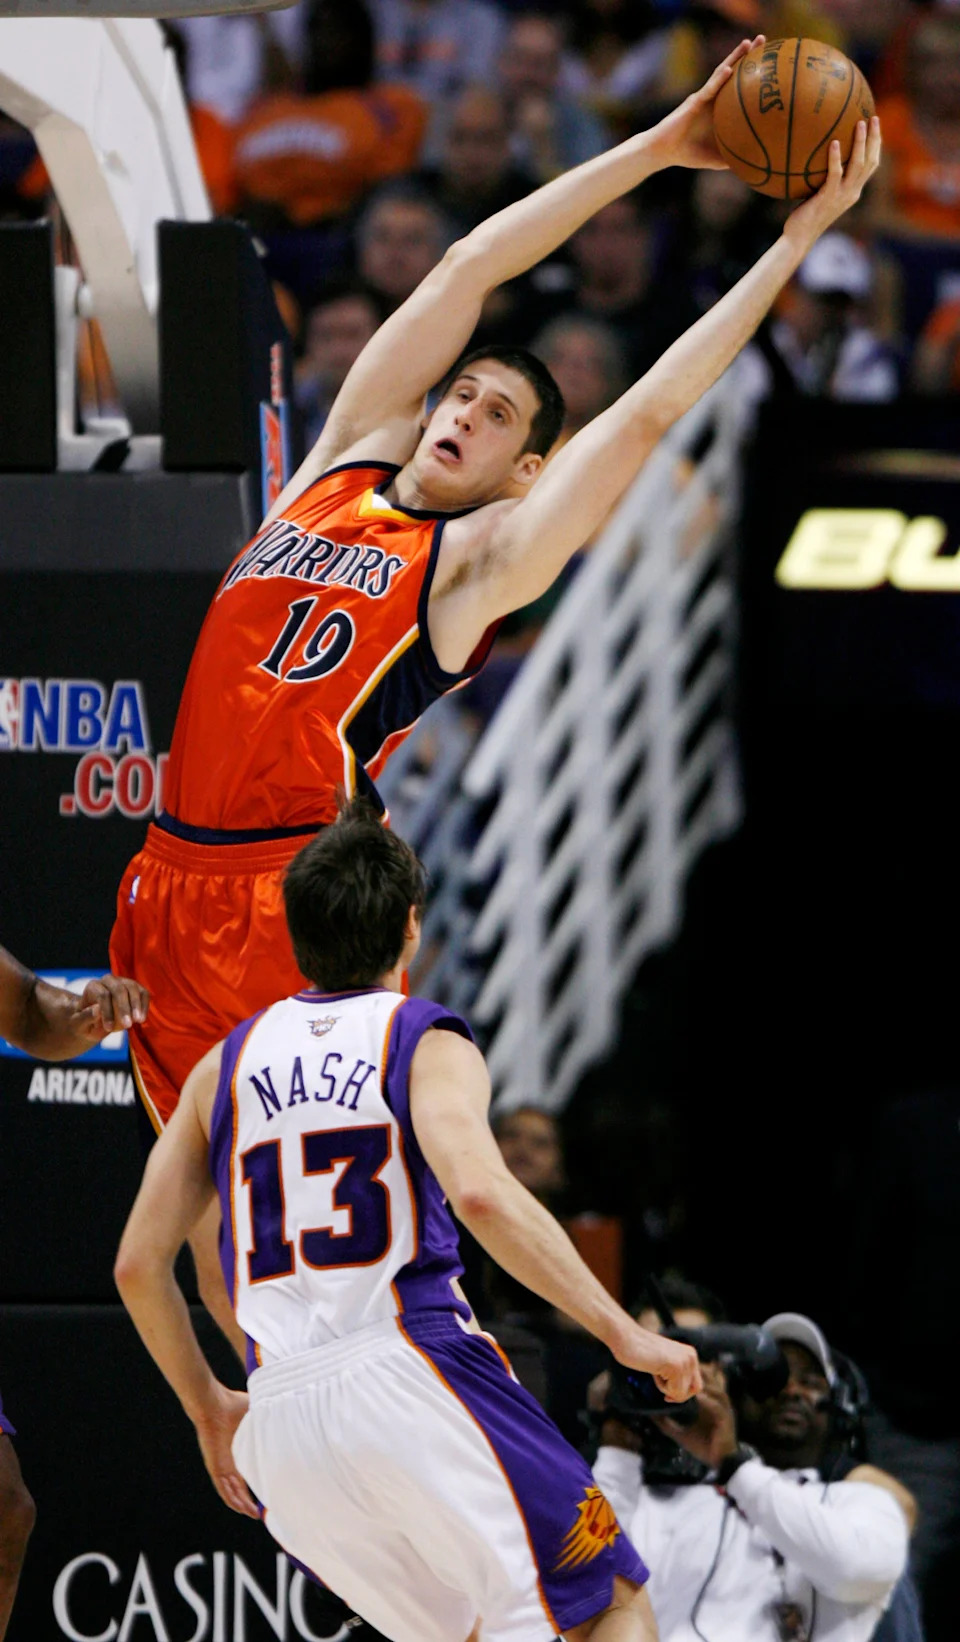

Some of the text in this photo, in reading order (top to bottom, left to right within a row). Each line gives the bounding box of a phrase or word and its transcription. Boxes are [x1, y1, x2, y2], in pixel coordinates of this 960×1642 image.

[258, 596, 355, 683] 19
[20, 679, 151, 752] NBA
[60, 751, 170, 817] .CO
[249, 1052, 376, 1121] NASH
[240, 1123, 392, 1285] 13
